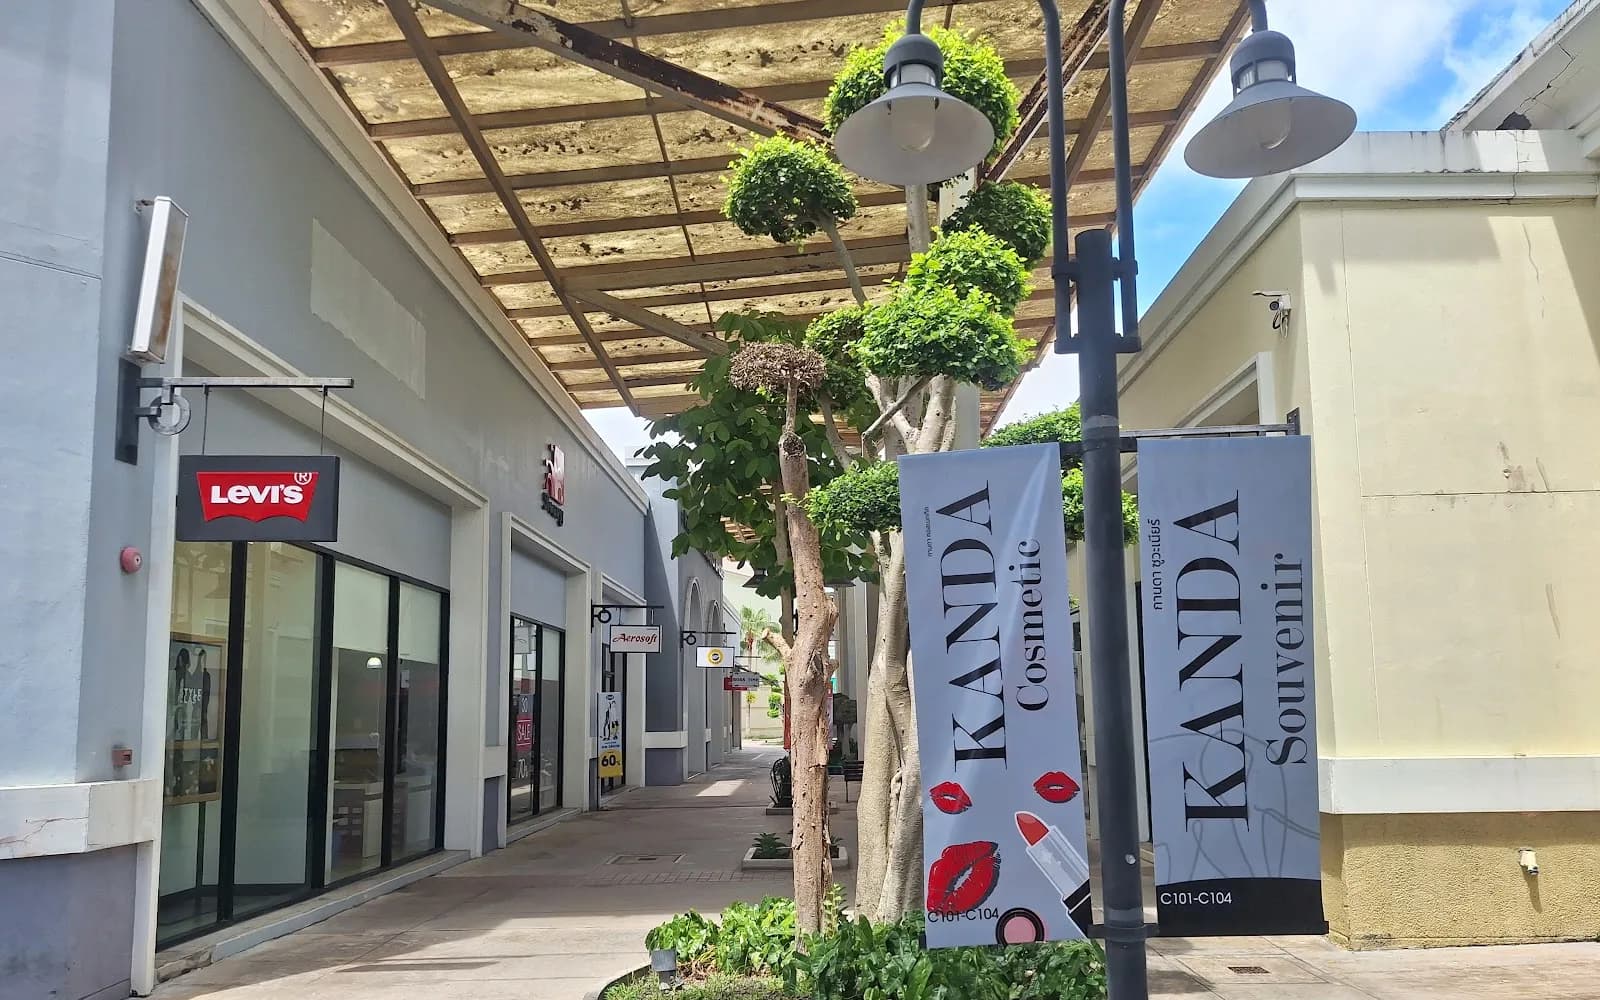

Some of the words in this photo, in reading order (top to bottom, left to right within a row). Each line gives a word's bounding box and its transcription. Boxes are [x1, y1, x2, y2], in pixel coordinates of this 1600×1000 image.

[1152, 571, 1163, 611] กานดา
[612, 633, 658, 645] Aerosoft
[935, 480, 1007, 773] KANDA
[1008, 539, 1049, 711] Cosmetic
[1173, 490, 1249, 832] KANDA
[1261, 552, 1308, 766] Souvenir
[517, 723, 531, 741] SALE
[927, 907, 999, 923] C101-C104
[1160, 891, 1232, 905] C101-C104
